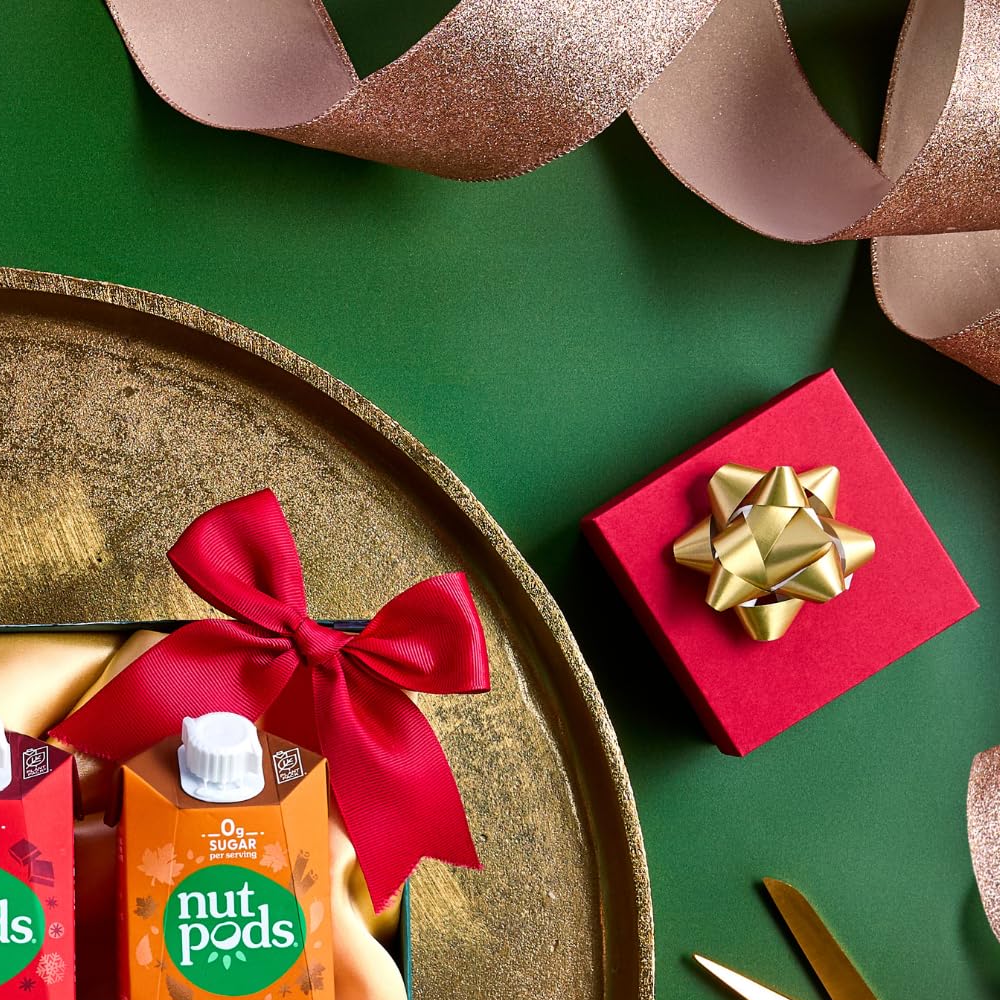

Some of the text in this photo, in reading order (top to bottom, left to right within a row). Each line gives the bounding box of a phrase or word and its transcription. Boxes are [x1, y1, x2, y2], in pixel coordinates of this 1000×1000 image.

[221, 818, 244, 838] 0g
[209, 839, 256, 851] SUGAR
[210, 851, 257, 861] per serving
[177, 882, 255, 919] nut
